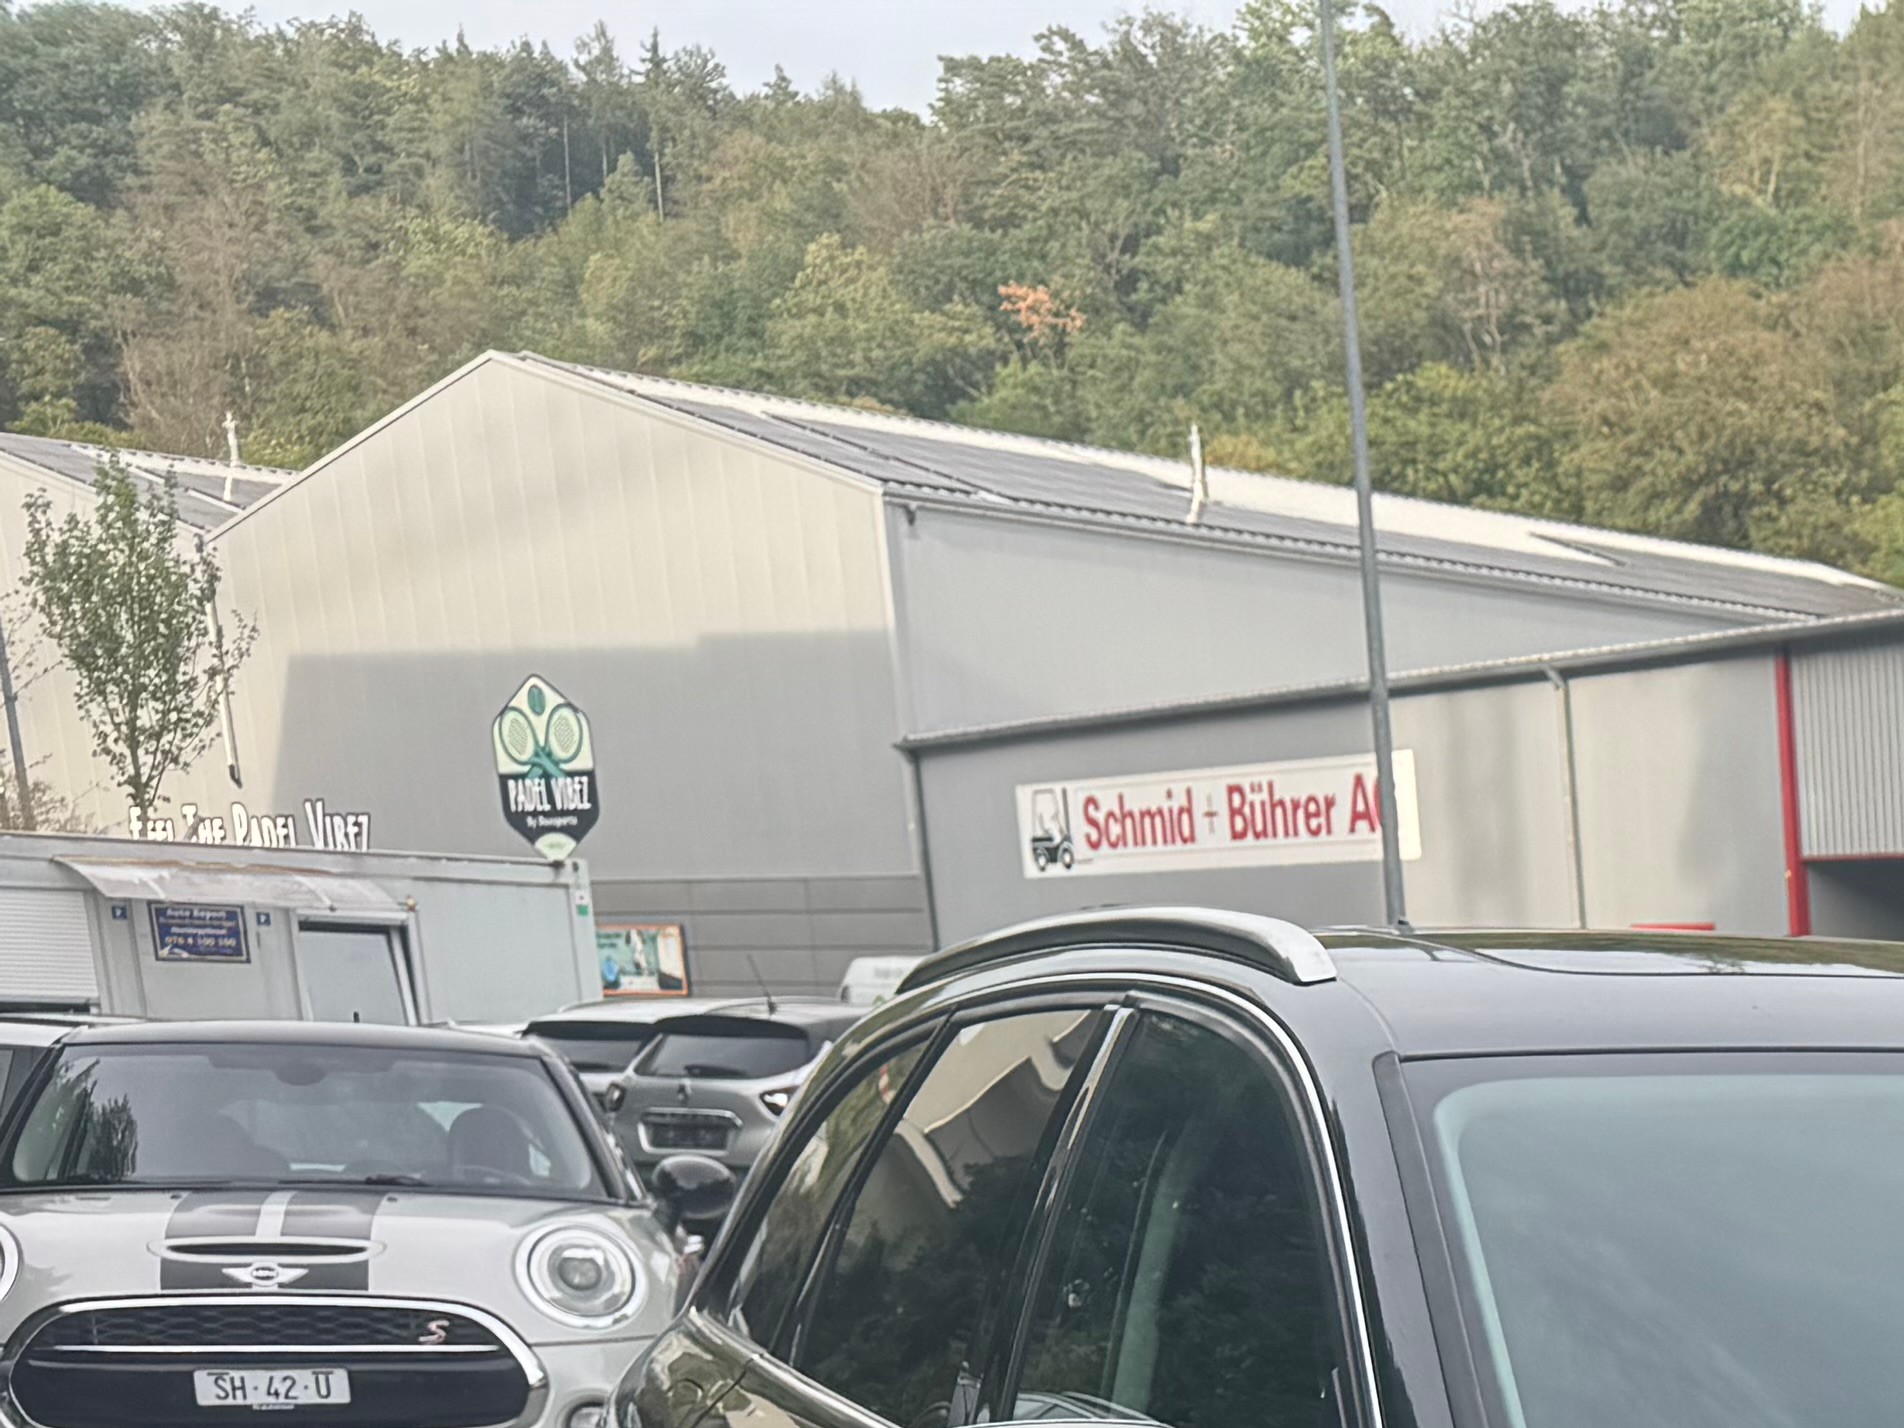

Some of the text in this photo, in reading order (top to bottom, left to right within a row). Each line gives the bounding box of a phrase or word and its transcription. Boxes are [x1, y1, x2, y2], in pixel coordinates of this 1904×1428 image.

[507, 775, 592, 813] PADEL VIBEZ
[1083, 786, 1196, 851] Schmid
[1225, 780, 1336, 842] Bührer
[1348, 772, 1382, 836] A
[417, 1319, 450, 1345] S
